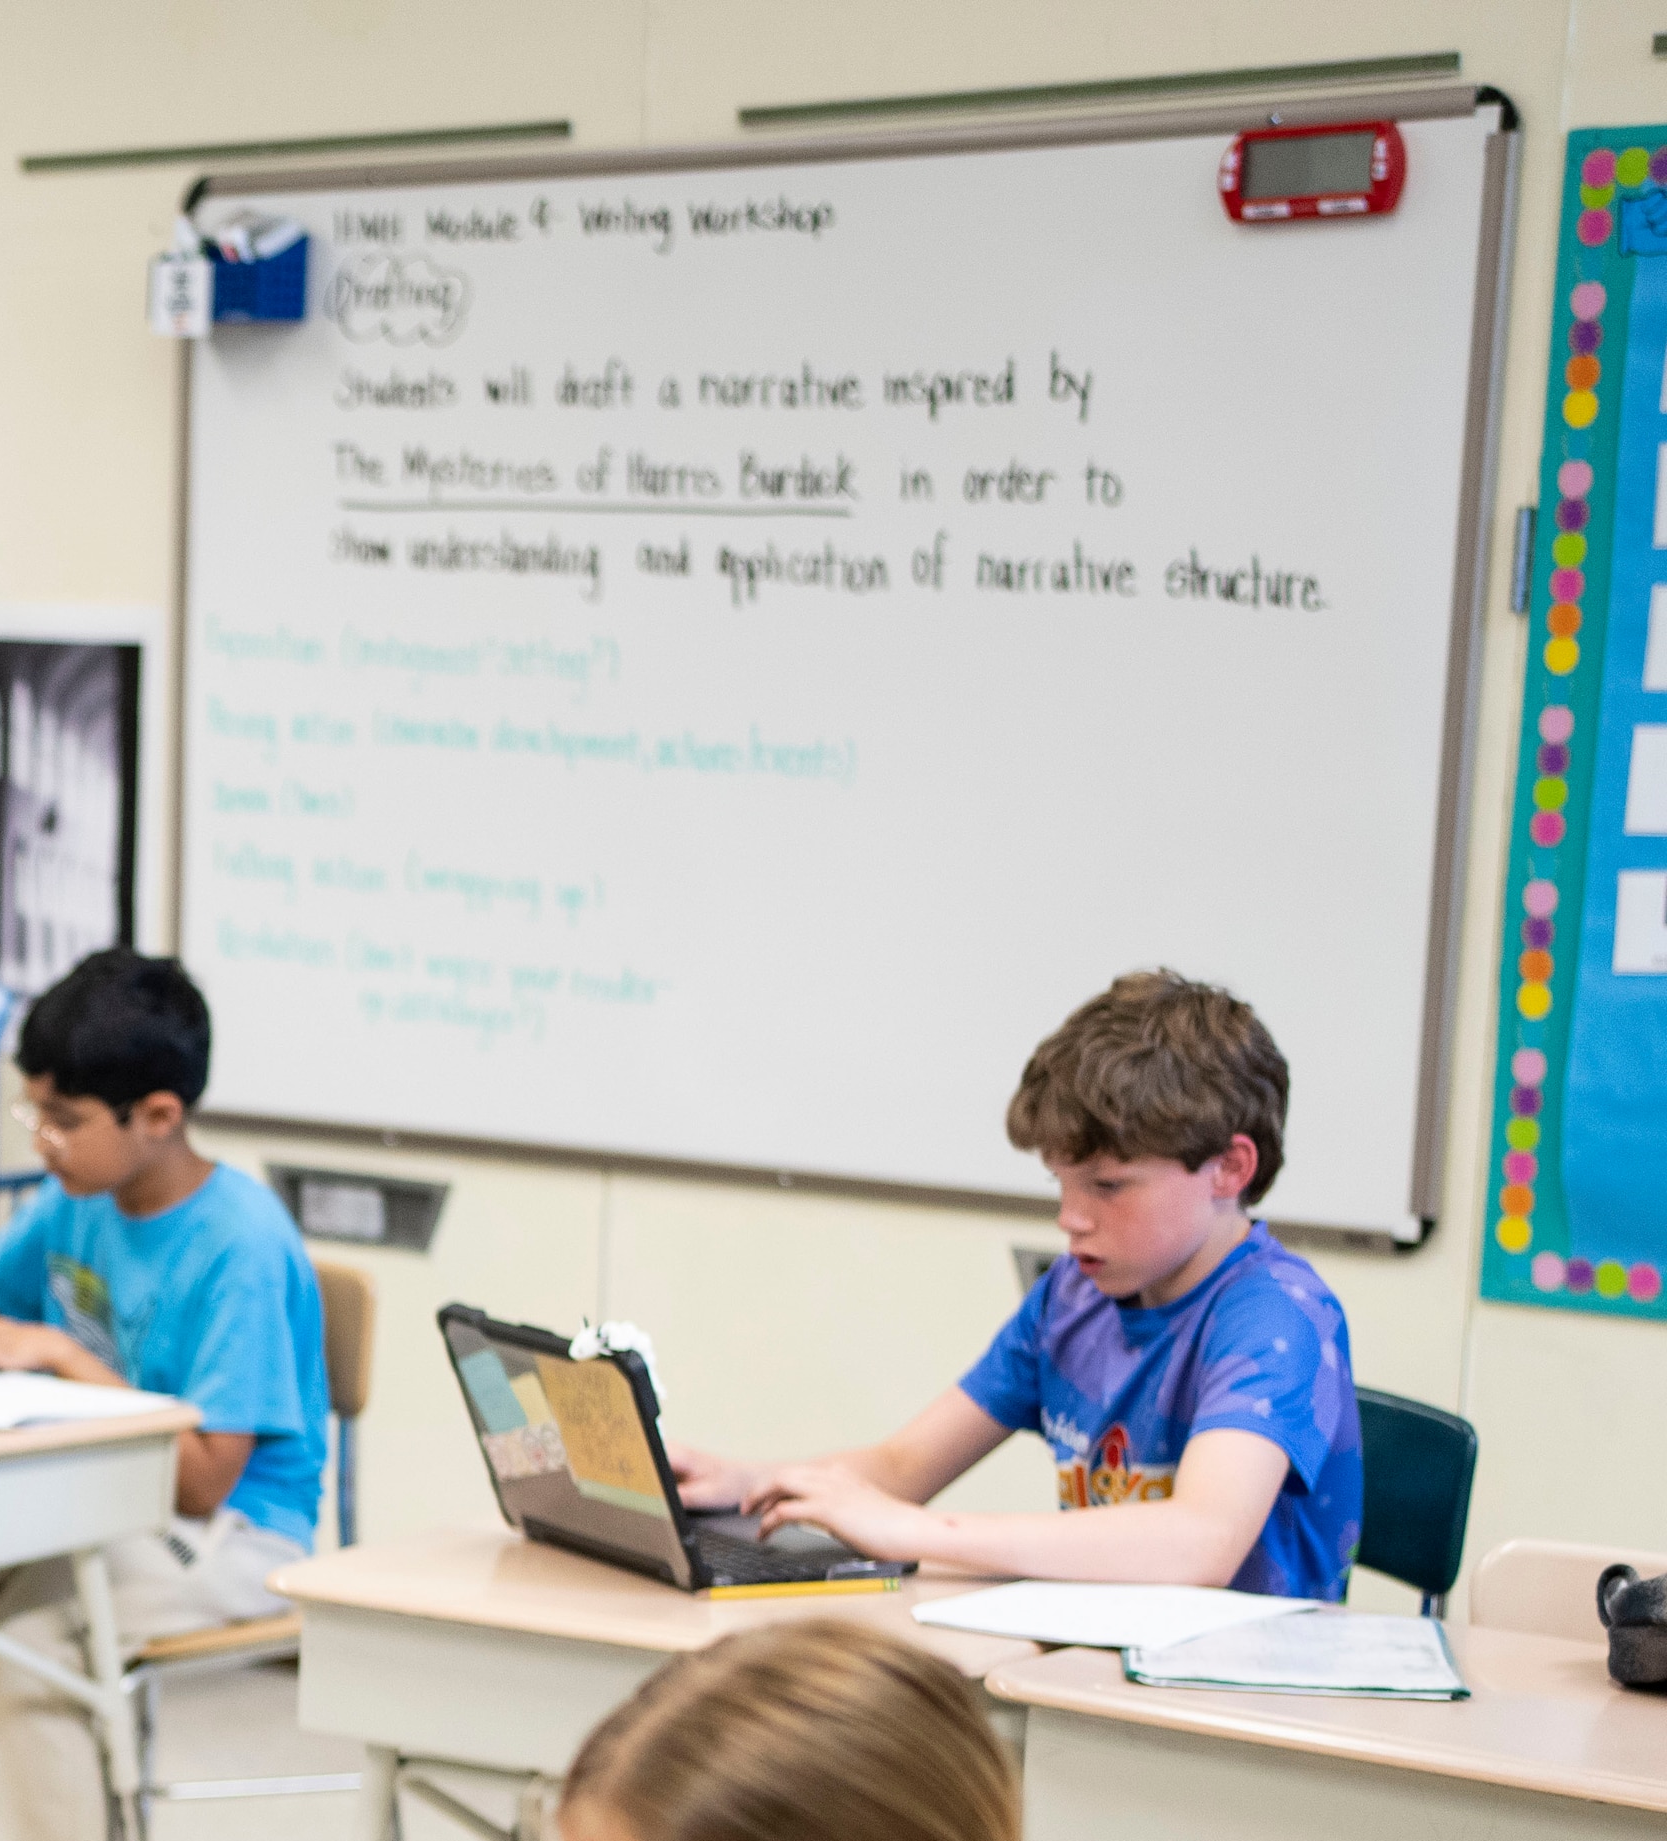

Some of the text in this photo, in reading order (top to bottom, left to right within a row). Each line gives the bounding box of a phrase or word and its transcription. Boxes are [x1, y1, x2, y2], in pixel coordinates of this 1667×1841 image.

[425, 203, 524, 242] Module
[579, 199, 675, 255] Writing
[688, 194, 837, 241] Workshop
[335, 347, 1094, 424] Students will draft a narrative inspired by
[334, 440, 1123, 507] The Mysteries of Harris Burdick in order to
[408, 526, 604, 605] understanding
[636, 532, 692, 578] and
[716, 537, 889, 610] application
[911, 528, 948, 593] of
[975, 538, 1137, 597] narrative
